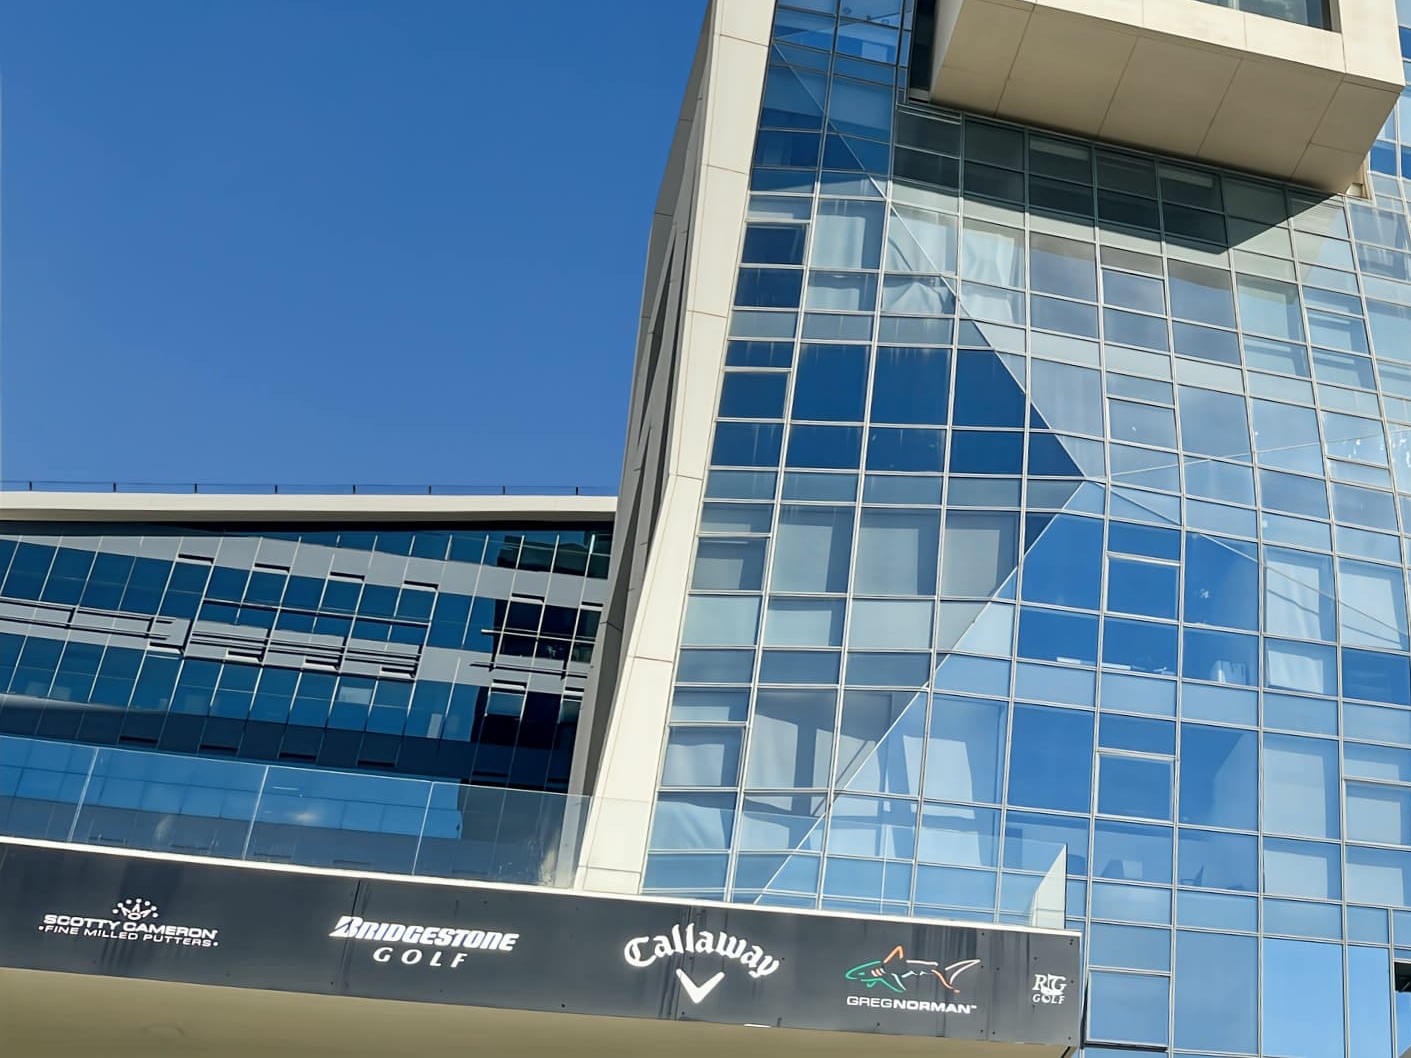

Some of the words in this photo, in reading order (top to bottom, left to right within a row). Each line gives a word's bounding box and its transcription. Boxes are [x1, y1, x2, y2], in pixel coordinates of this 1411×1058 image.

[43, 914, 121, 930] SCOTTY
[123, 921, 218, 940] CAMERON
[44, 925, 79, 935] FINE
[83, 929, 139, 941] MILLED
[142, 933, 213, 948] PUTTERS
[328, 915, 520, 952] BRIDGESTONE
[372, 946, 468, 968] GOLF
[623, 922, 780, 979] Callaway
[1032, 993, 1066, 1005] GOLF
